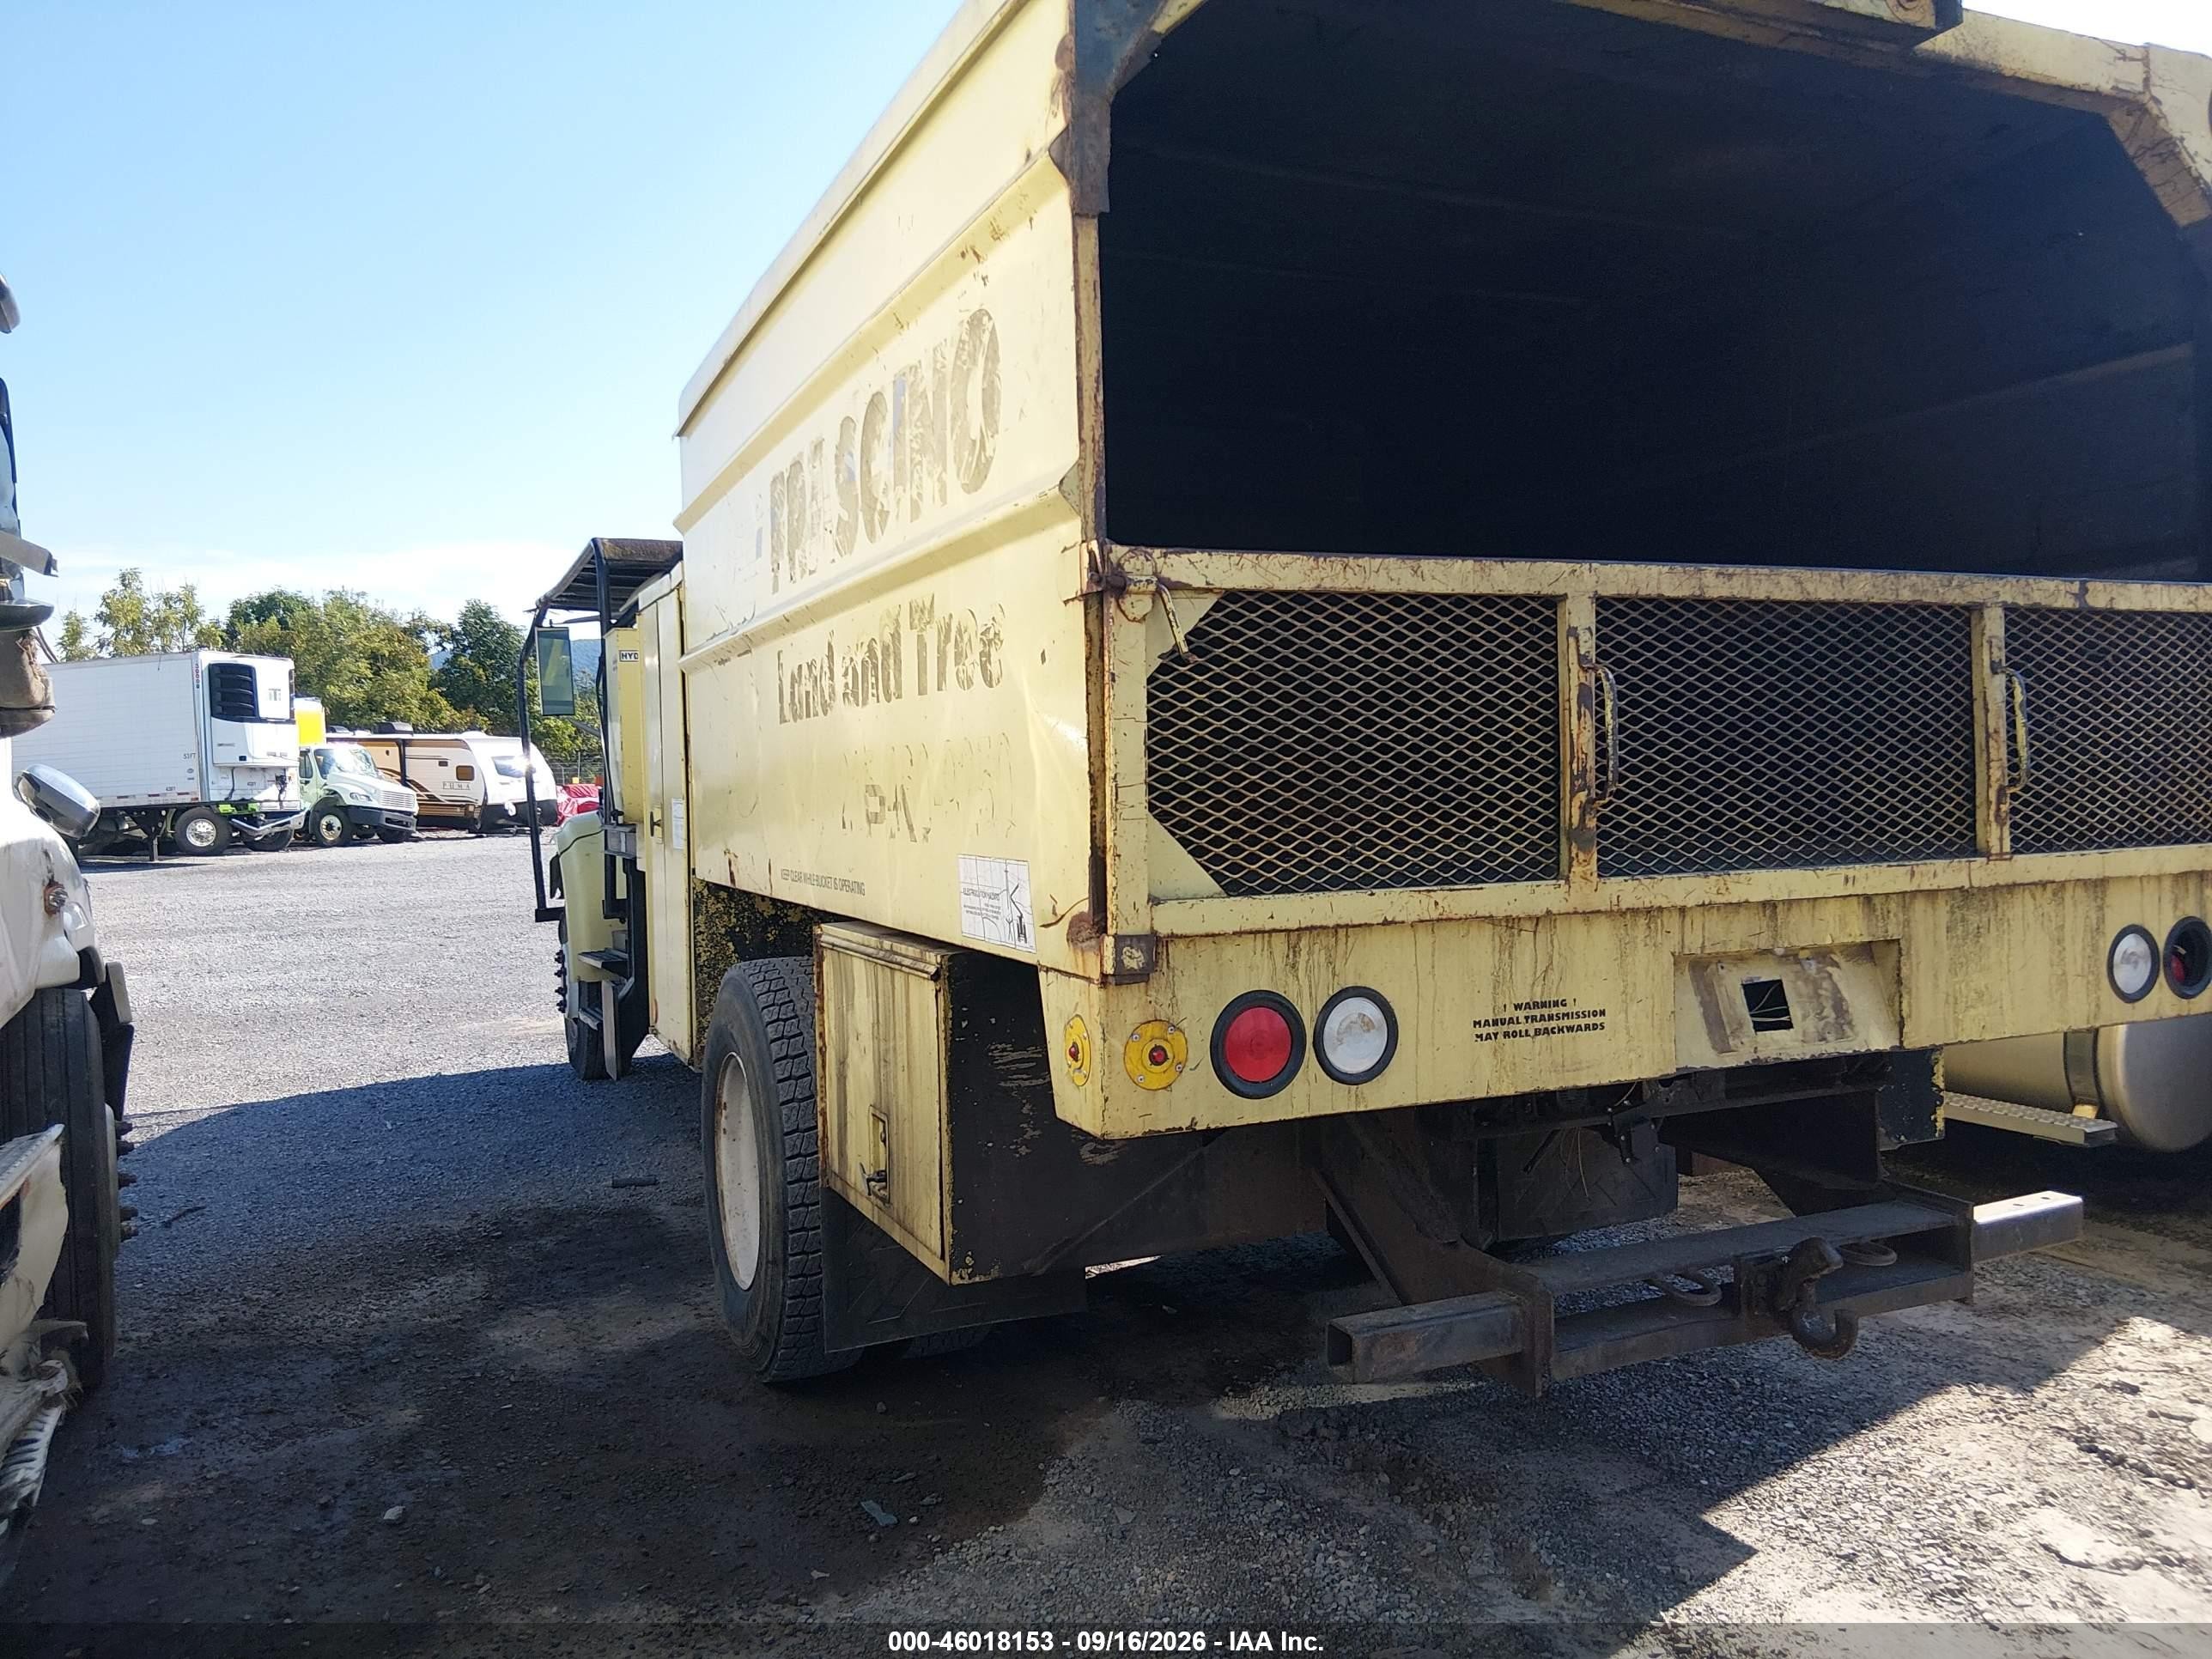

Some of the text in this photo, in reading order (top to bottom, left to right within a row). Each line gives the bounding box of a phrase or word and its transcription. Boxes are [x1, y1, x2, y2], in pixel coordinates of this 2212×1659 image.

[777, 593, 1006, 726] Land and Tree
[838, 878, 866, 896] OPERATING
[1513, 998, 1567, 1012] WARNING
[1473, 1008, 1607, 1029] MANUAL TRANSMISSION
[1474, 1022, 1606, 1042] MAY ROLL BACKWARDS
